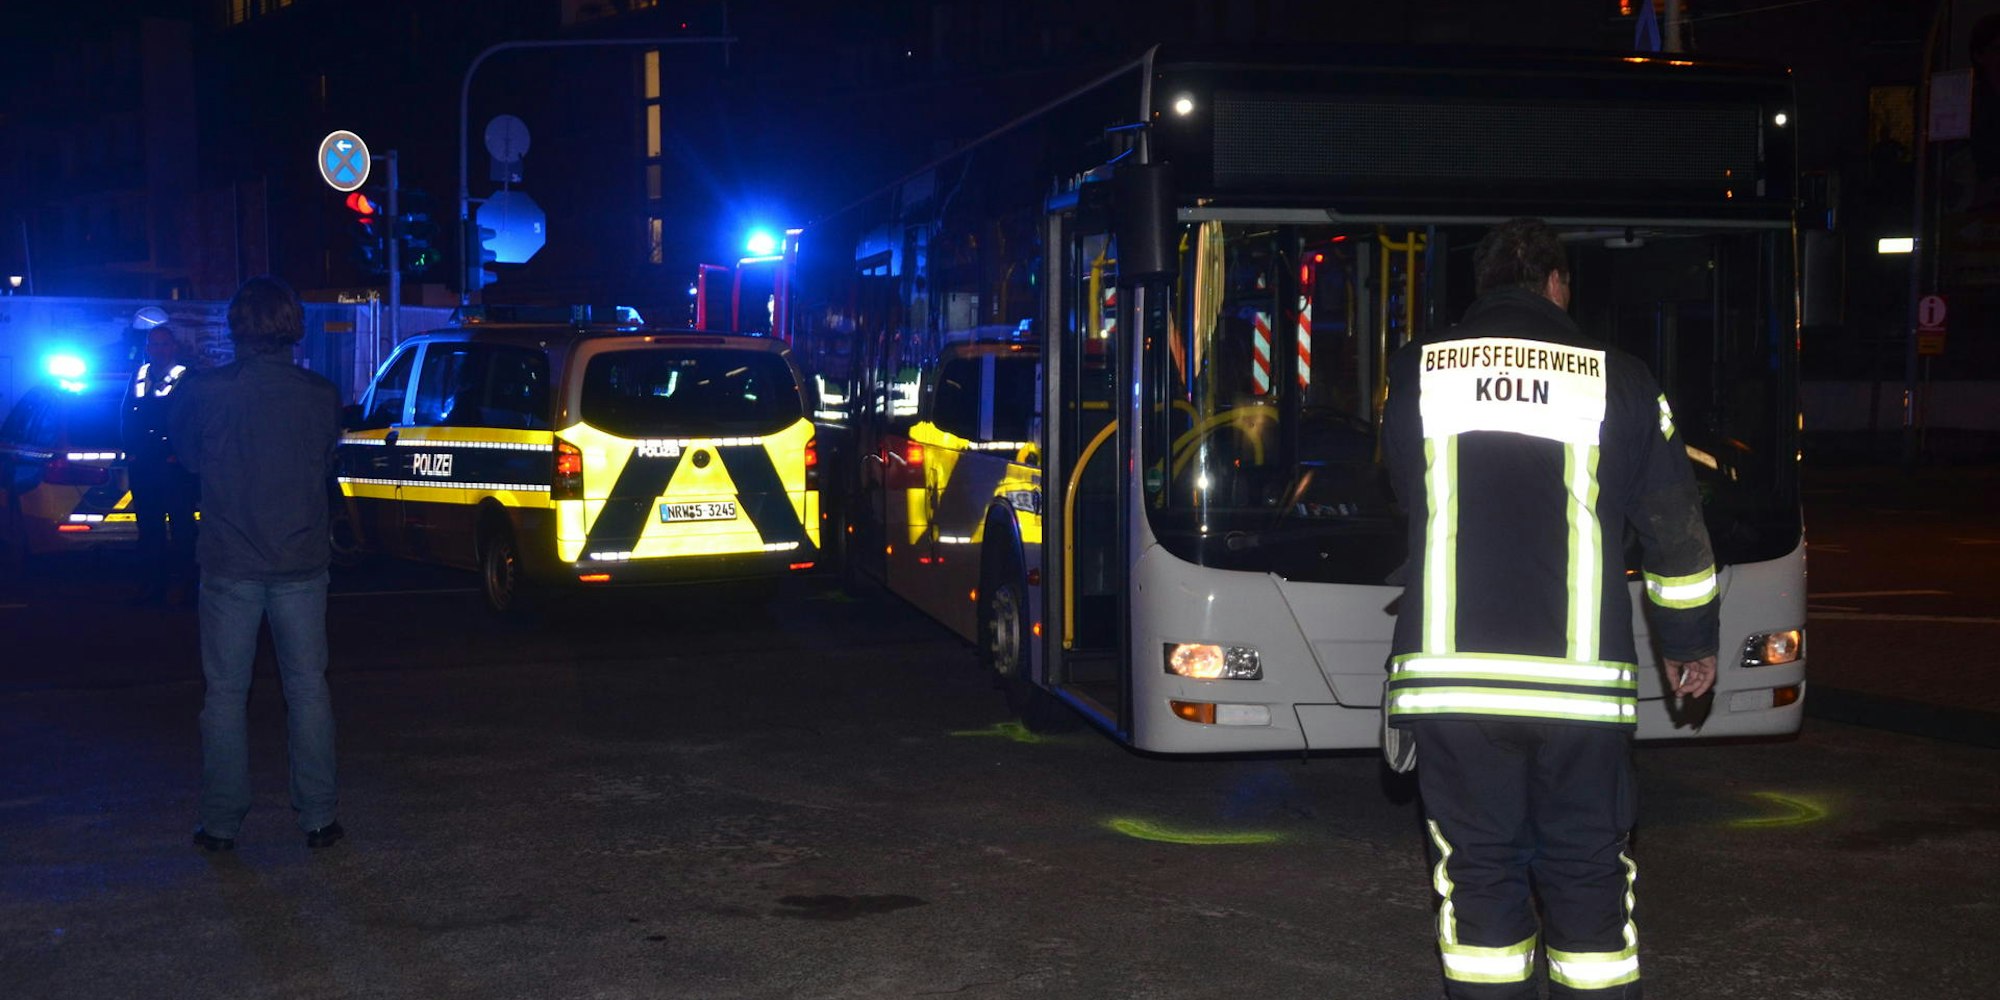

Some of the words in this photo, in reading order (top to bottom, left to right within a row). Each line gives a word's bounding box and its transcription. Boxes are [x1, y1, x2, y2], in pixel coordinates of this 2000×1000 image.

[1426, 345, 1600, 378] BERUFSFEUERWEHR
[1476, 372, 1549, 405] KÖLN
[412, 453, 453, 476] POLIZEI
[667, 504, 690, 518] NRW
